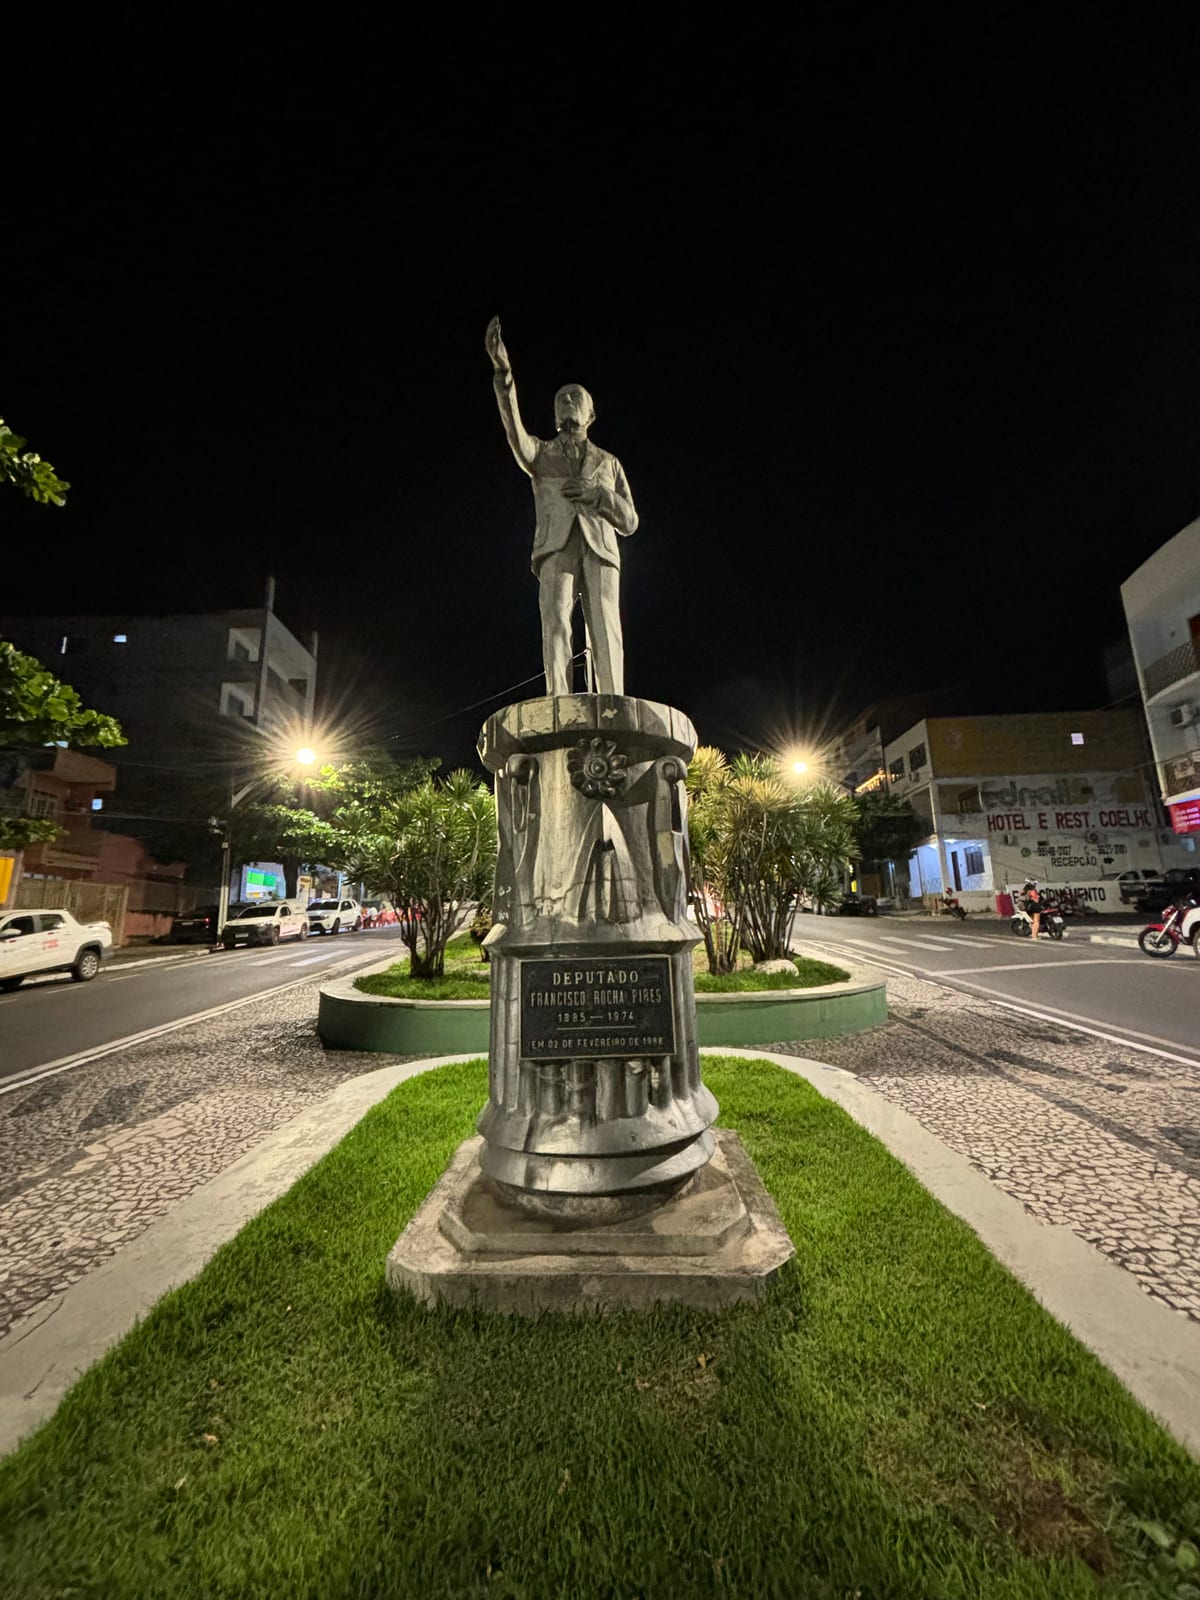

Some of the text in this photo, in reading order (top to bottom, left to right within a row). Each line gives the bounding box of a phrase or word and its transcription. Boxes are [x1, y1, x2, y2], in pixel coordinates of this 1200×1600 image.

[987, 812, 1030, 832] HOTEL
[1038, 812, 1048, 830] E
[1056, 810, 1096, 829] REST.
[552, 970, 639, 986] DEPUTADO
[530, 988, 662, 1008] FRANCISCO ROCHA PIRES
[557, 1012, 587, 1024] 1885
[607, 1011, 634, 1022] 1974
[531, 1040, 545, 1050] EM
[562, 1039, 573, 1049] DE
[577, 1037, 626, 1048] FEVEREIRO
[629, 1036, 640, 1046] DE
